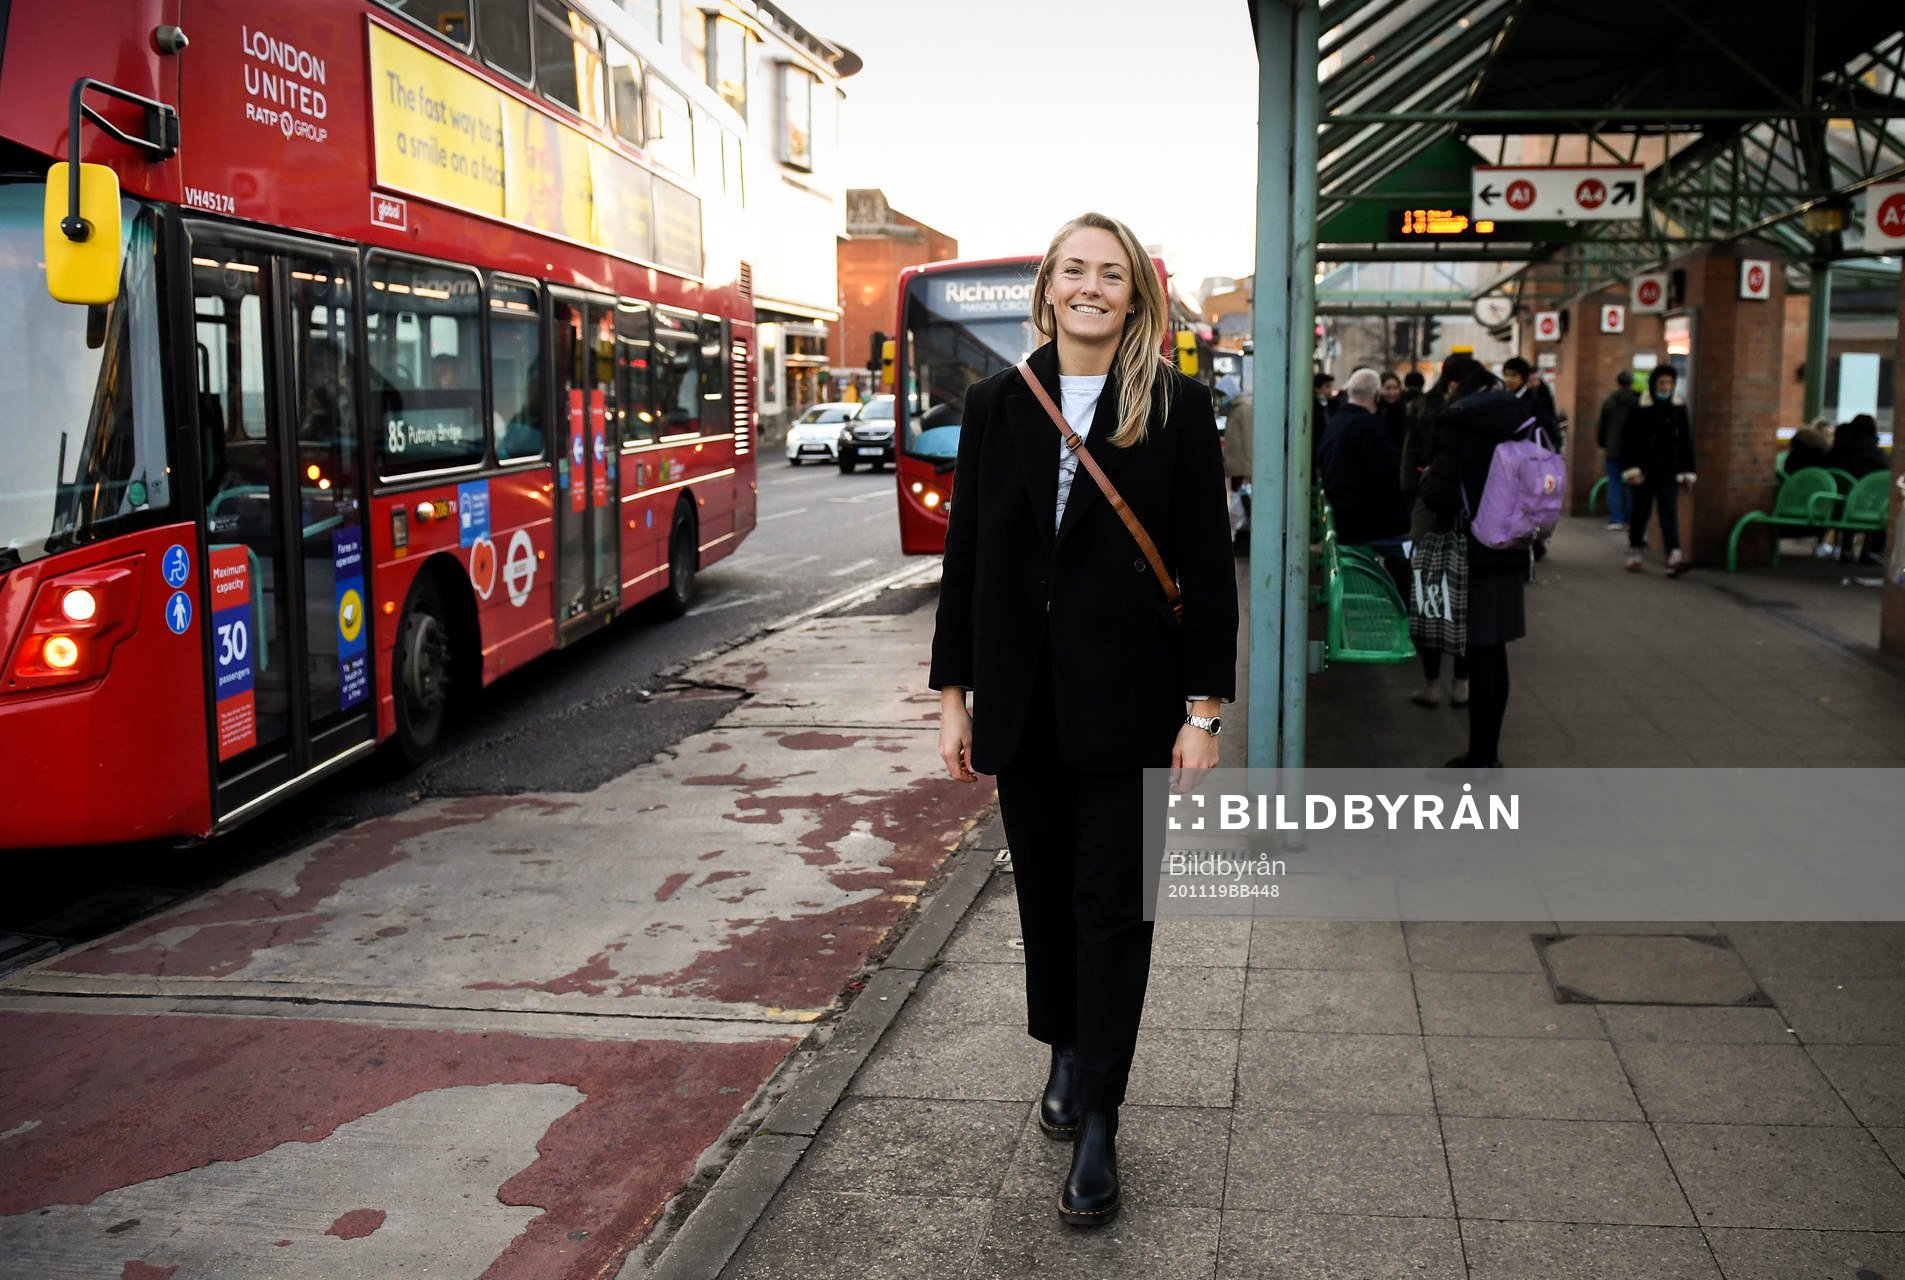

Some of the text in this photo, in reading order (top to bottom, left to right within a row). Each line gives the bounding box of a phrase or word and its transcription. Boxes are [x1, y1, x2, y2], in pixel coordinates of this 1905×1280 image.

[242, 25, 326, 85] LONDON
[244, 64, 328, 119] UNITED
[387, 71, 416, 111] The
[420, 86, 447, 125] fast
[246, 103, 328, 143] RATP GROUP
[410, 136, 448, 169] smile
[185, 186, 235, 214] VH45174
[945, 282, 1035, 303] Richmon
[388, 420, 406, 453] 85
[213, 564, 246, 579] Maximum
[216, 579, 244, 594] capacity
[217, 620, 247, 666] 30
[219, 667, 250, 686] passengers
